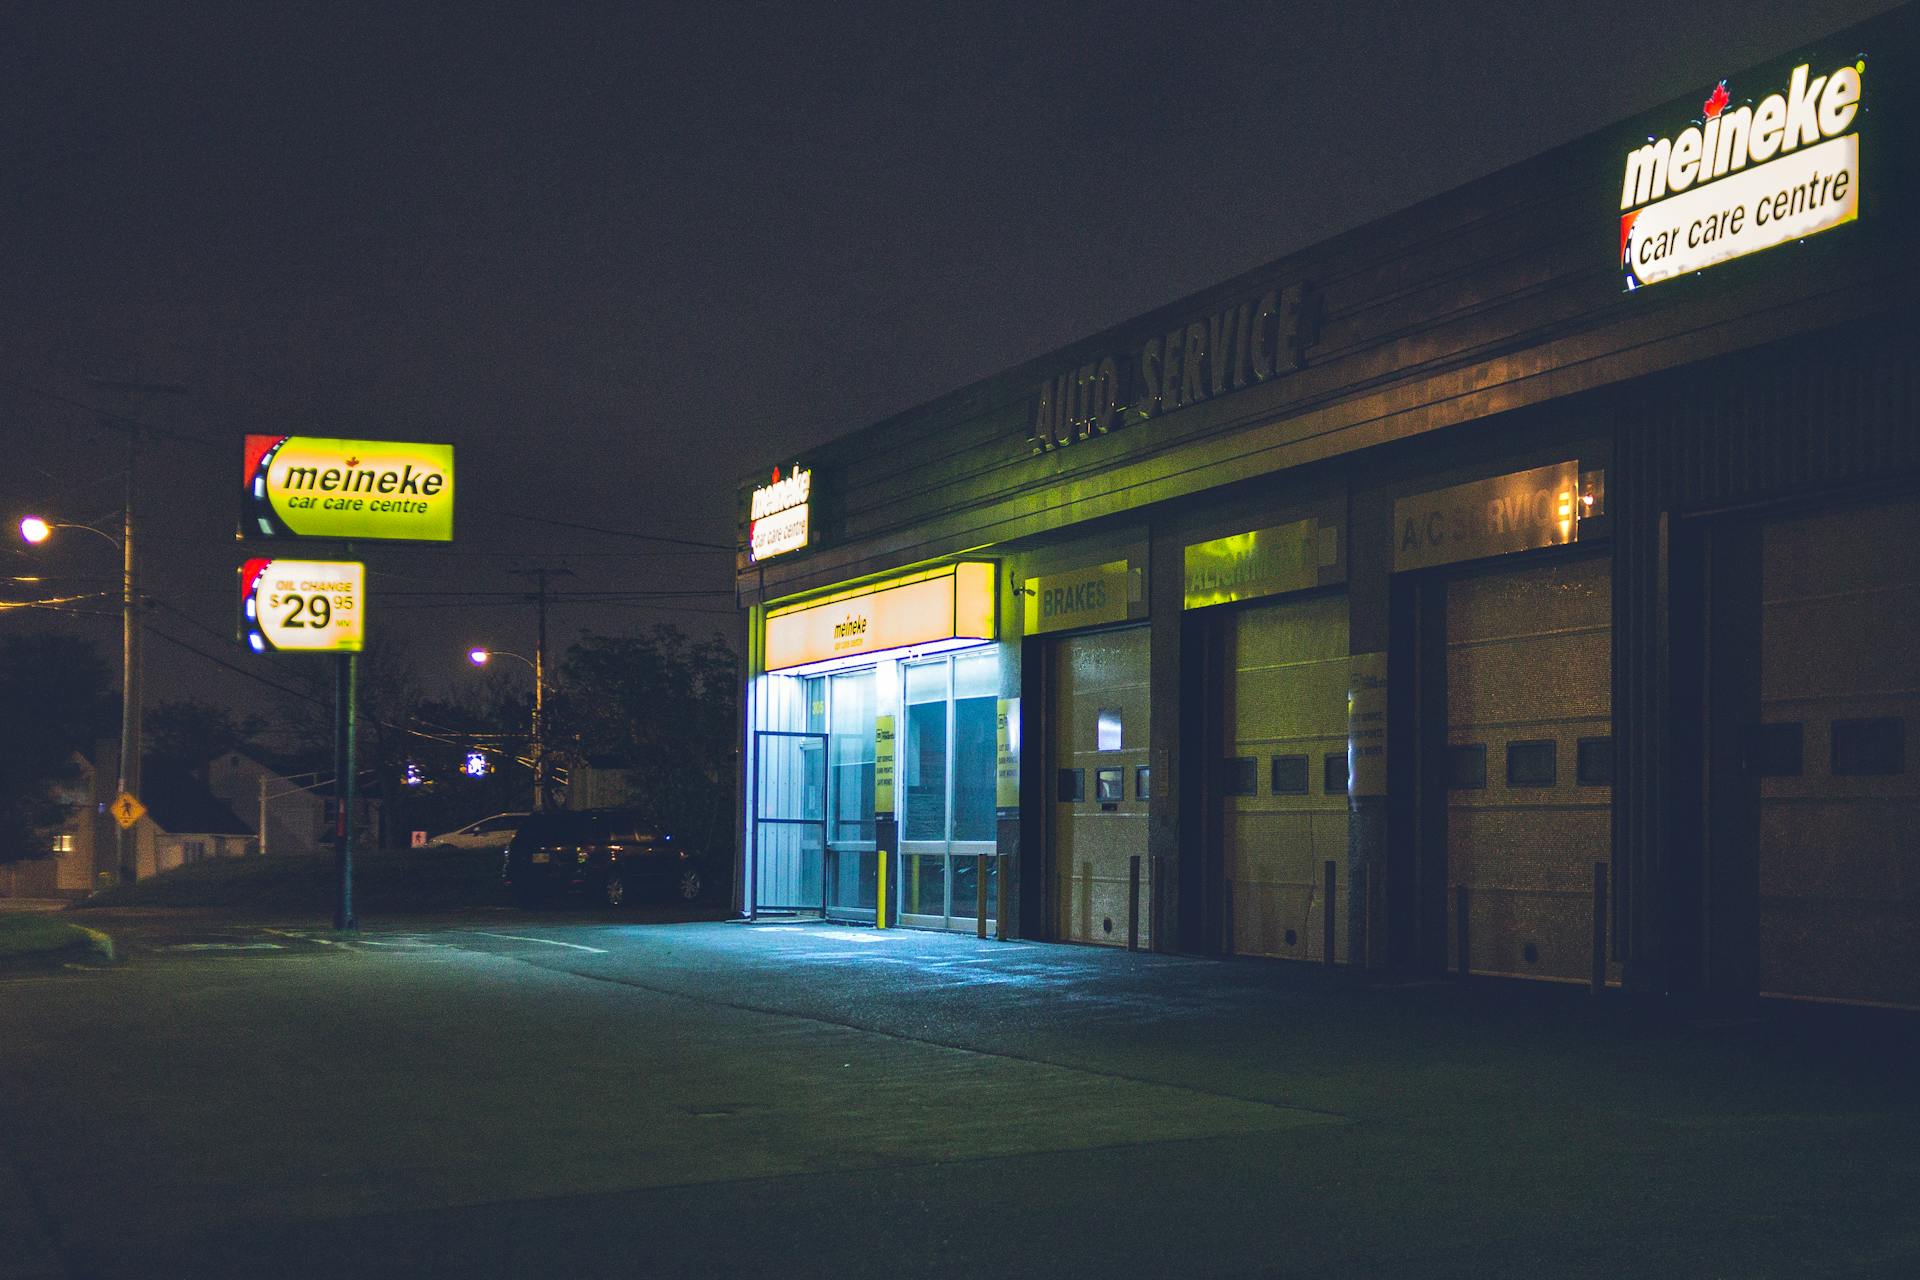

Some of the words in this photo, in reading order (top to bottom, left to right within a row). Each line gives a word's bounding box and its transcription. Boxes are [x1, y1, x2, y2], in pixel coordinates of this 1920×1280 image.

[1620, 63, 1862, 210] meineke
[1638, 226, 1680, 265] car
[1687, 203, 1746, 249] care
[1755, 168, 1850, 227] centre
[1031, 353, 1120, 456] AUTO
[1137, 281, 1310, 420] SERVICE
[283, 464, 444, 496] meineke
[288, 496, 318, 509] car
[323, 497, 364, 512] care
[370, 499, 428, 514] centre
[275, 580, 296, 591] OIL
[300, 581, 353, 593] CHANGE
[1043, 578, 1108, 617] BRAKES
[833, 613, 867, 639] meineke
